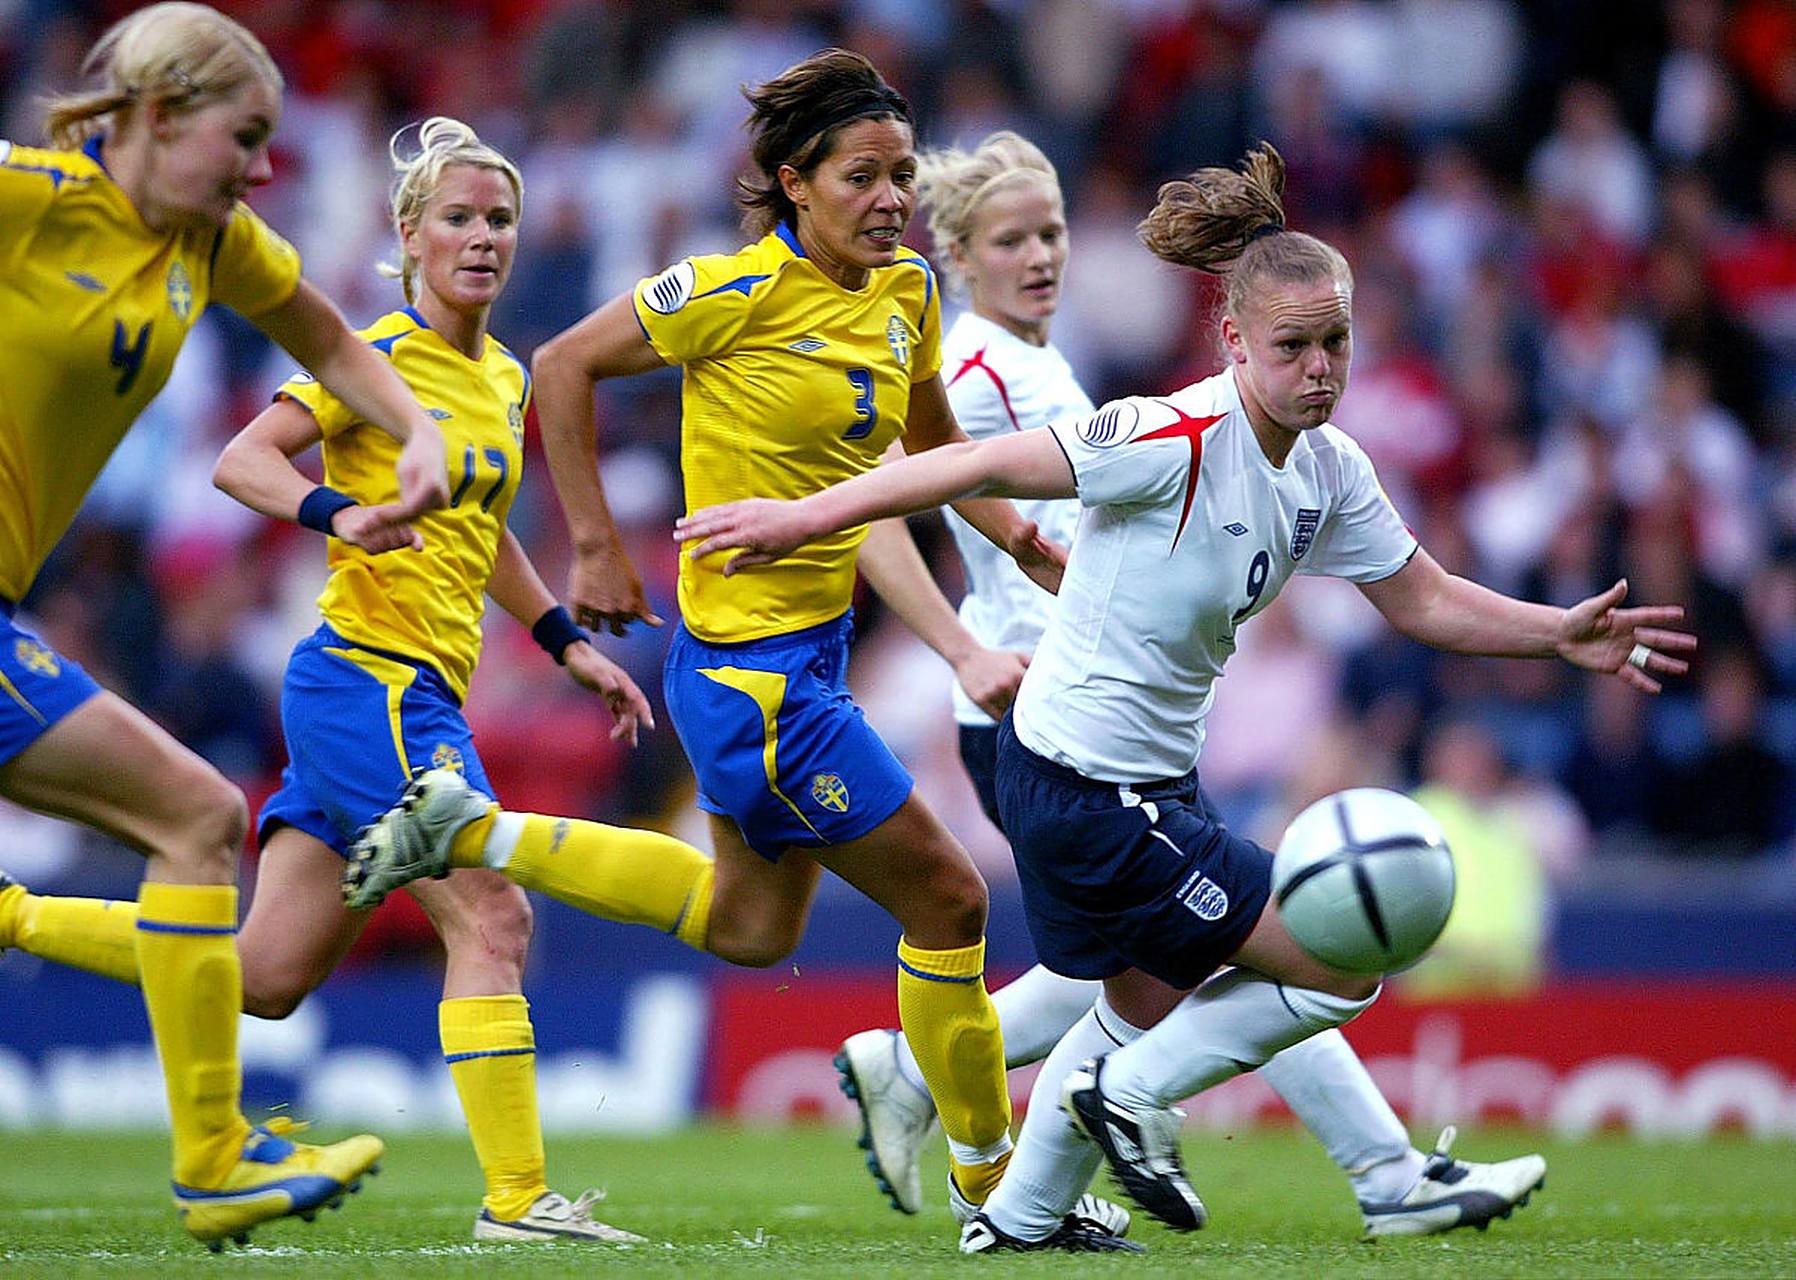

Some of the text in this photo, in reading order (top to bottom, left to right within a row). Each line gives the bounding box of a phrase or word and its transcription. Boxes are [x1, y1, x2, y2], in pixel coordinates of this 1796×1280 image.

[109, 316, 153, 397] 4
[841, 366, 877, 440] 3
[449, 443, 508, 514] 17
[1231, 550, 1270, 614] 9
